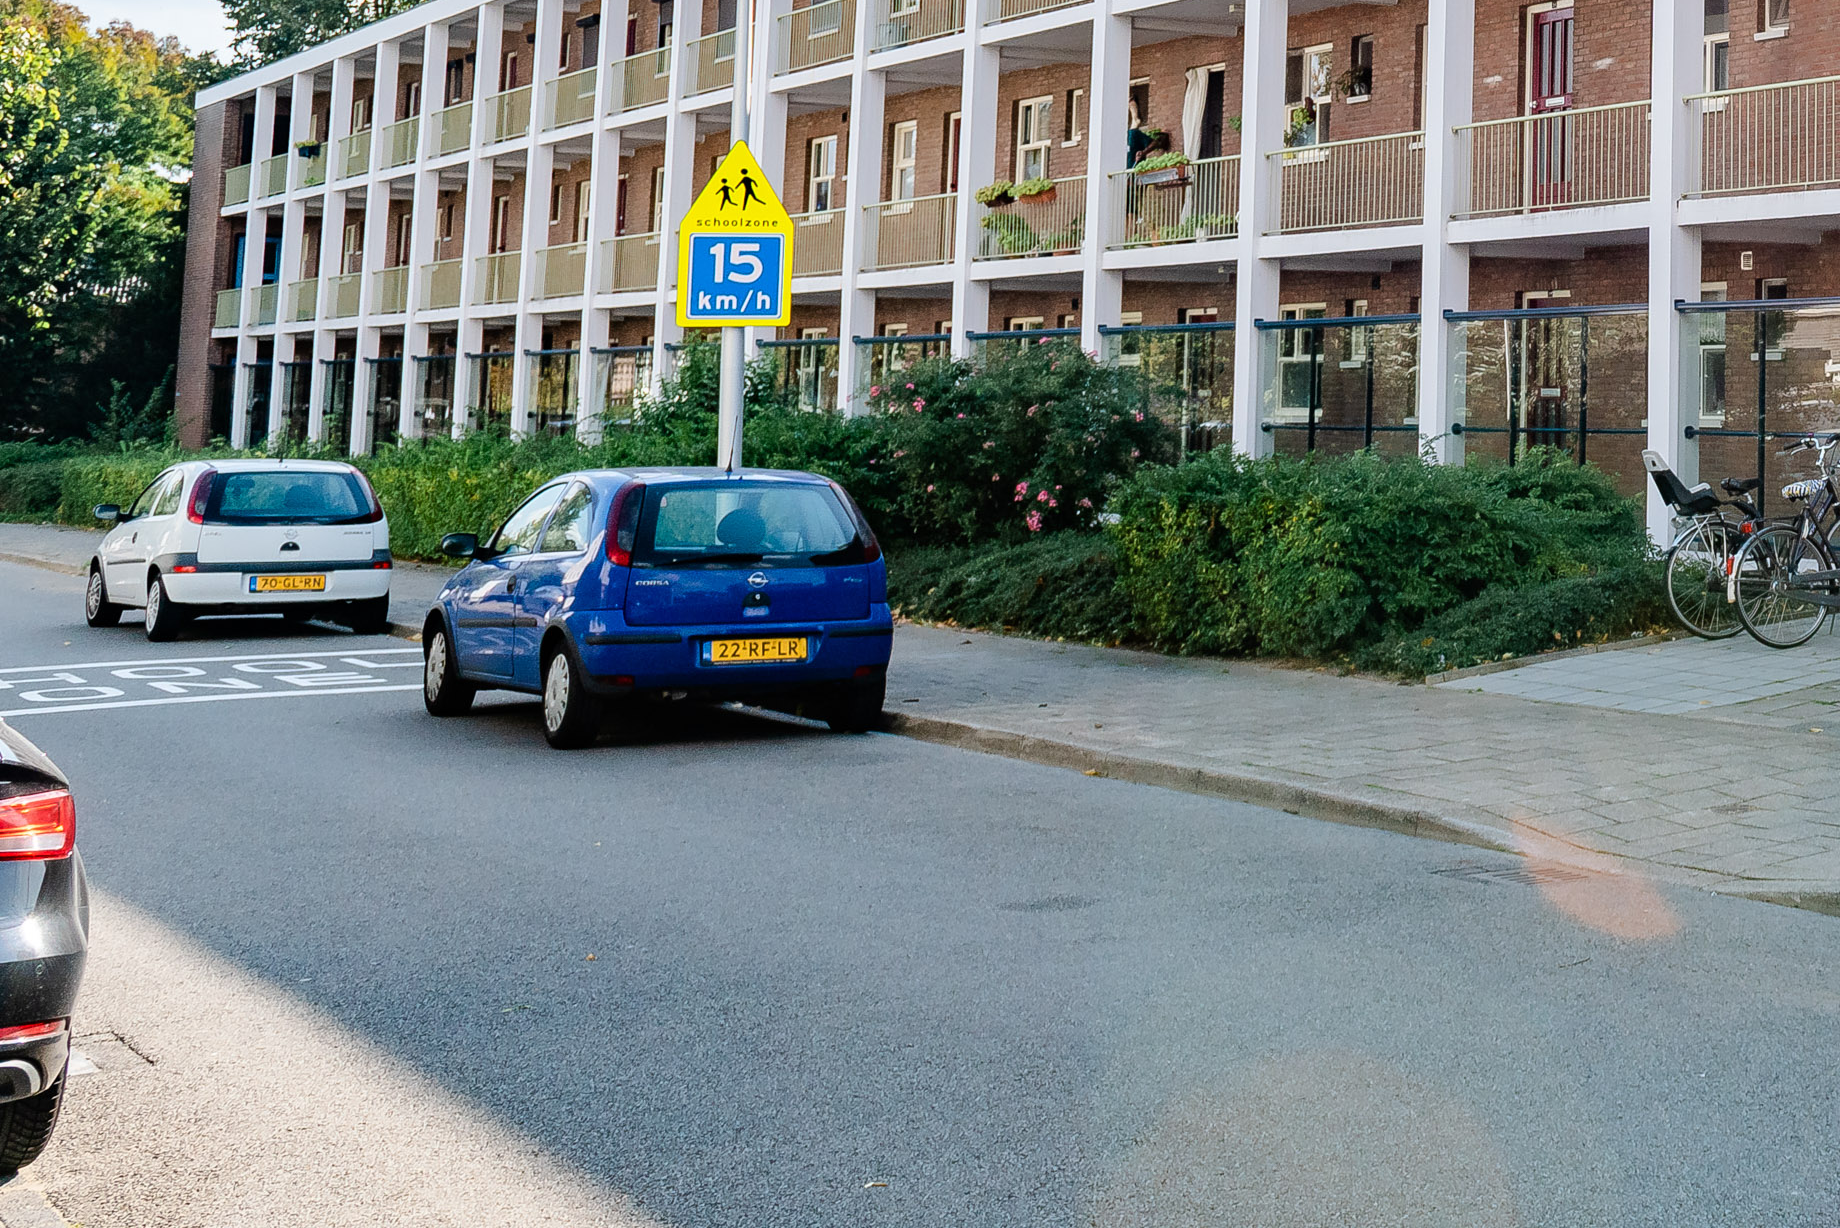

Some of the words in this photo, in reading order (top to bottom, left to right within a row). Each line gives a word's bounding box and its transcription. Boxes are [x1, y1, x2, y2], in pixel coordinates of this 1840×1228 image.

[696, 217, 779, 228] schoolzone
[709, 242, 764, 284] 15
[698, 289, 771, 313] km/h
[260, 576, 323, 590] 70-GL-RN
